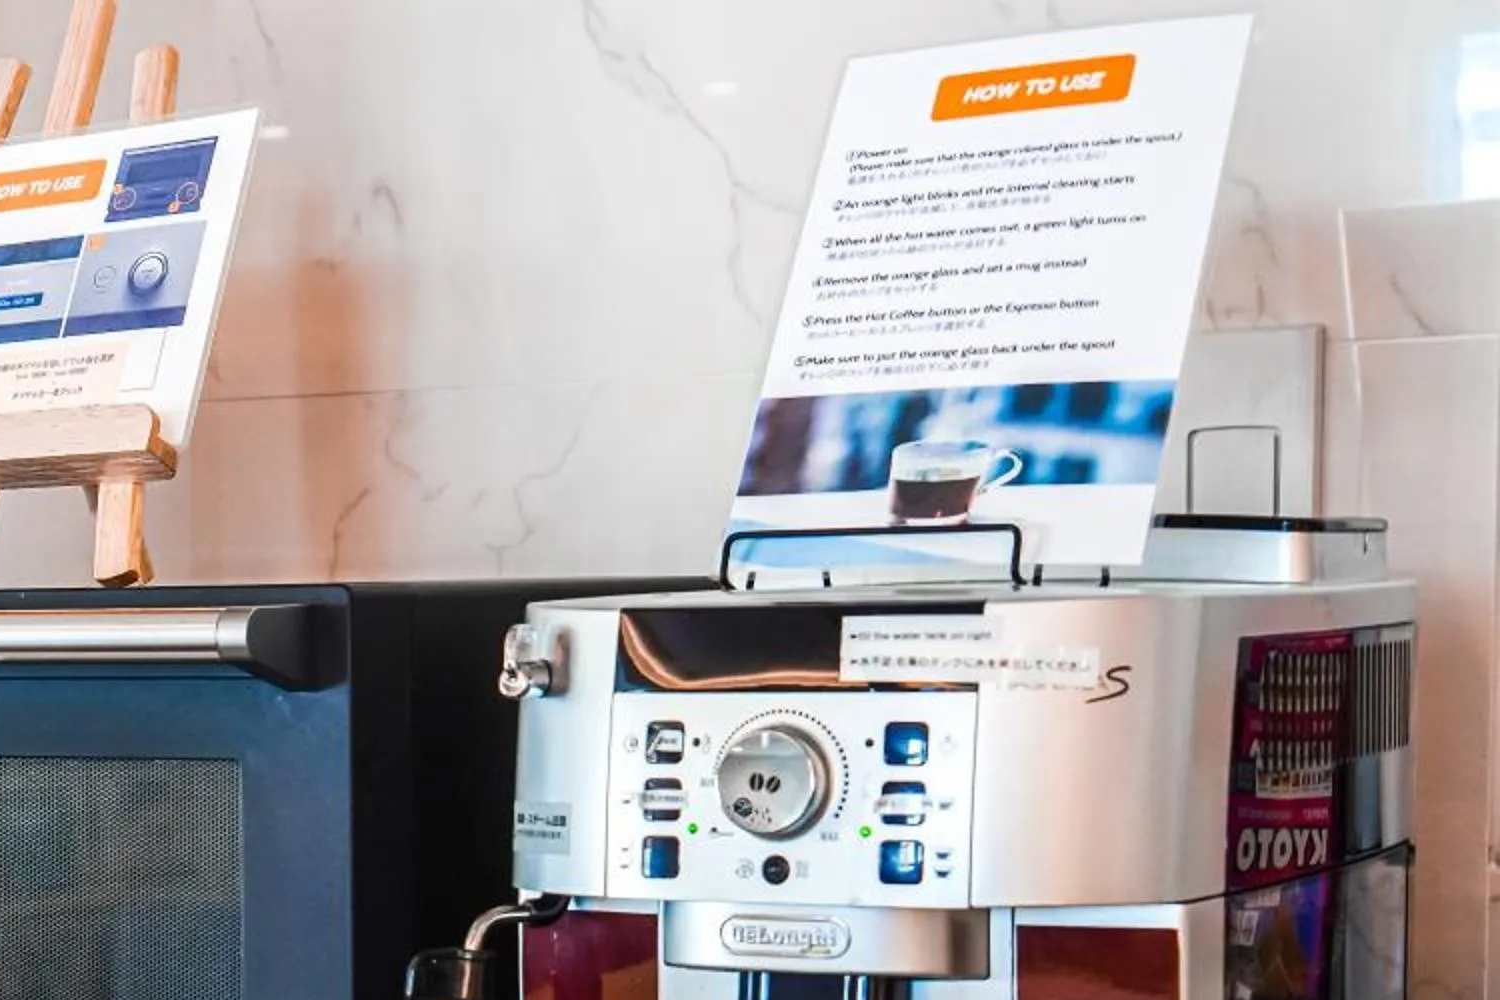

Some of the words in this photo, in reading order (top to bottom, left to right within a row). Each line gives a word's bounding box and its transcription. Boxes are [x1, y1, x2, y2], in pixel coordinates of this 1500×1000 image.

[963, 81, 1021, 104] HOW
[1025, 77, 1056, 96] TO
[1060, 71, 1107, 92] USE
[28, 179, 52, 196] TO
[53, 174, 87, 192] USE
[962, 186, 983, 198] and
[985, 185, 1004, 195] the
[885, 232, 901, 243] the
[904, 230, 923, 241] hot
[926, 228, 957, 239] water
[871, 272, 889, 283] the
[891, 270, 930, 281] orange
[932, 267, 958, 280] glass
[961, 263, 984, 275] and
[1016, 261, 1041, 273] mug
[1044, 257, 1088, 269] instead
[846, 313, 863, 323] the
[889, 308, 925, 320] Coffee
[928, 306, 967, 318] button
[984, 302, 1002, 313] the
[1005, 301, 1057, 314] Espresso
[1059, 298, 1100, 310] button
[837, 354, 860, 364] sure
[863, 352, 875, 362] to
[876, 351, 895, 363] put
[899, 348, 916, 360] the
[919, 347, 959, 359] orange
[961, 344, 989, 358] glass
[991, 343, 1017, 353] back
[1021, 341, 1055, 352] under
[1059, 339, 1078, 350] the
[1081, 338, 1115, 351] spout
